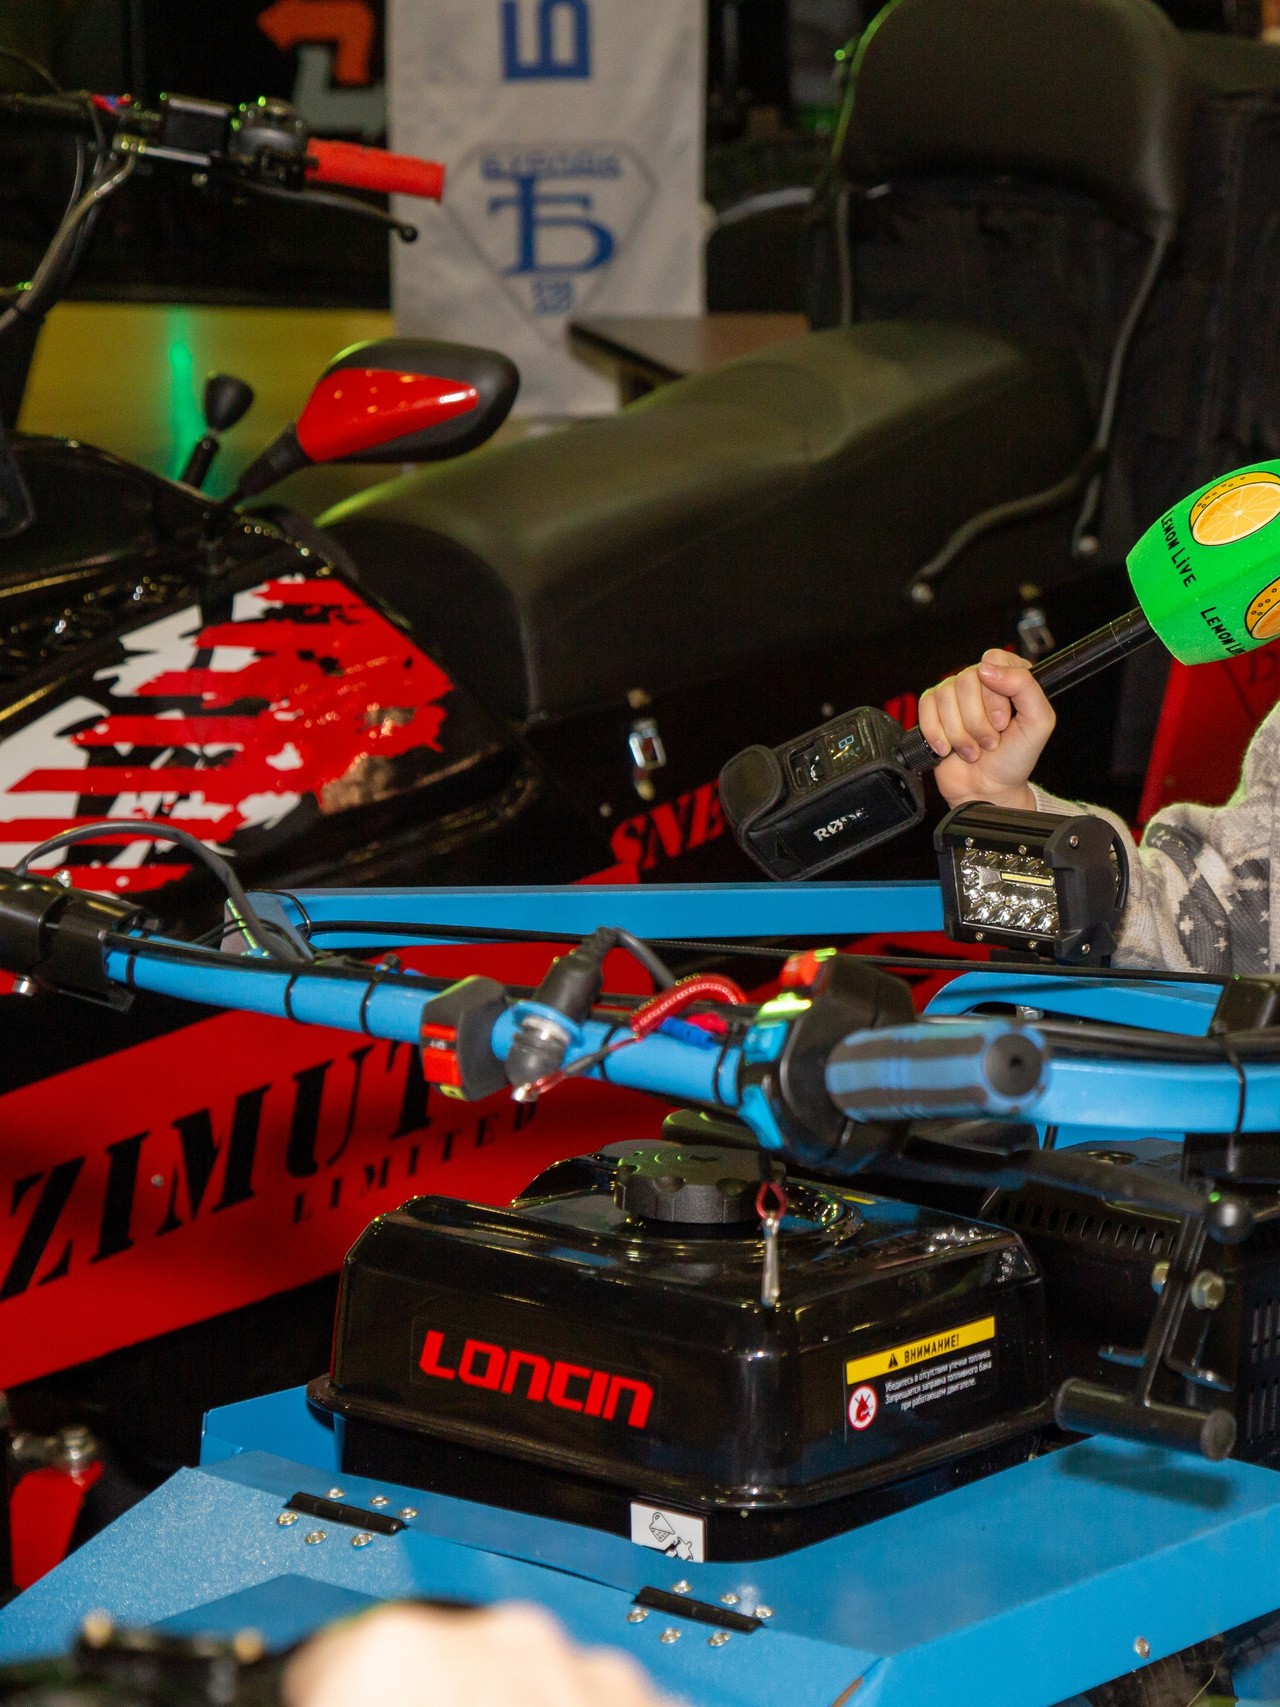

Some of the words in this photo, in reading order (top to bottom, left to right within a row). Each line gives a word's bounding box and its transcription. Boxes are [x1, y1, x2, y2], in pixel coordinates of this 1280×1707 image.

[1161, 509, 1179, 550] LEMON
[1200, 606, 1236, 647] LEMON
[903, 1333, 960, 1364] ВНИМАНИЕ!
[419, 1330, 654, 1430] LONCIN
[885, 1375, 914, 1393] Убедитесь
[919, 1364, 949, 1381] отсутствии
[949, 1358, 968, 1373] утечки
[968, 1349, 993, 1364] топлива.
[885, 1385, 921, 1404] Запрещается
[921, 1377, 947, 1392] заправка
[947, 1365, 979, 1383] топливного
[978, 1360, 993, 1373] бака
[900, 1400, 912, 1412] при
[911, 1388, 947, 1409] работающем
[946, 1378, 977, 1396] двигателе.
